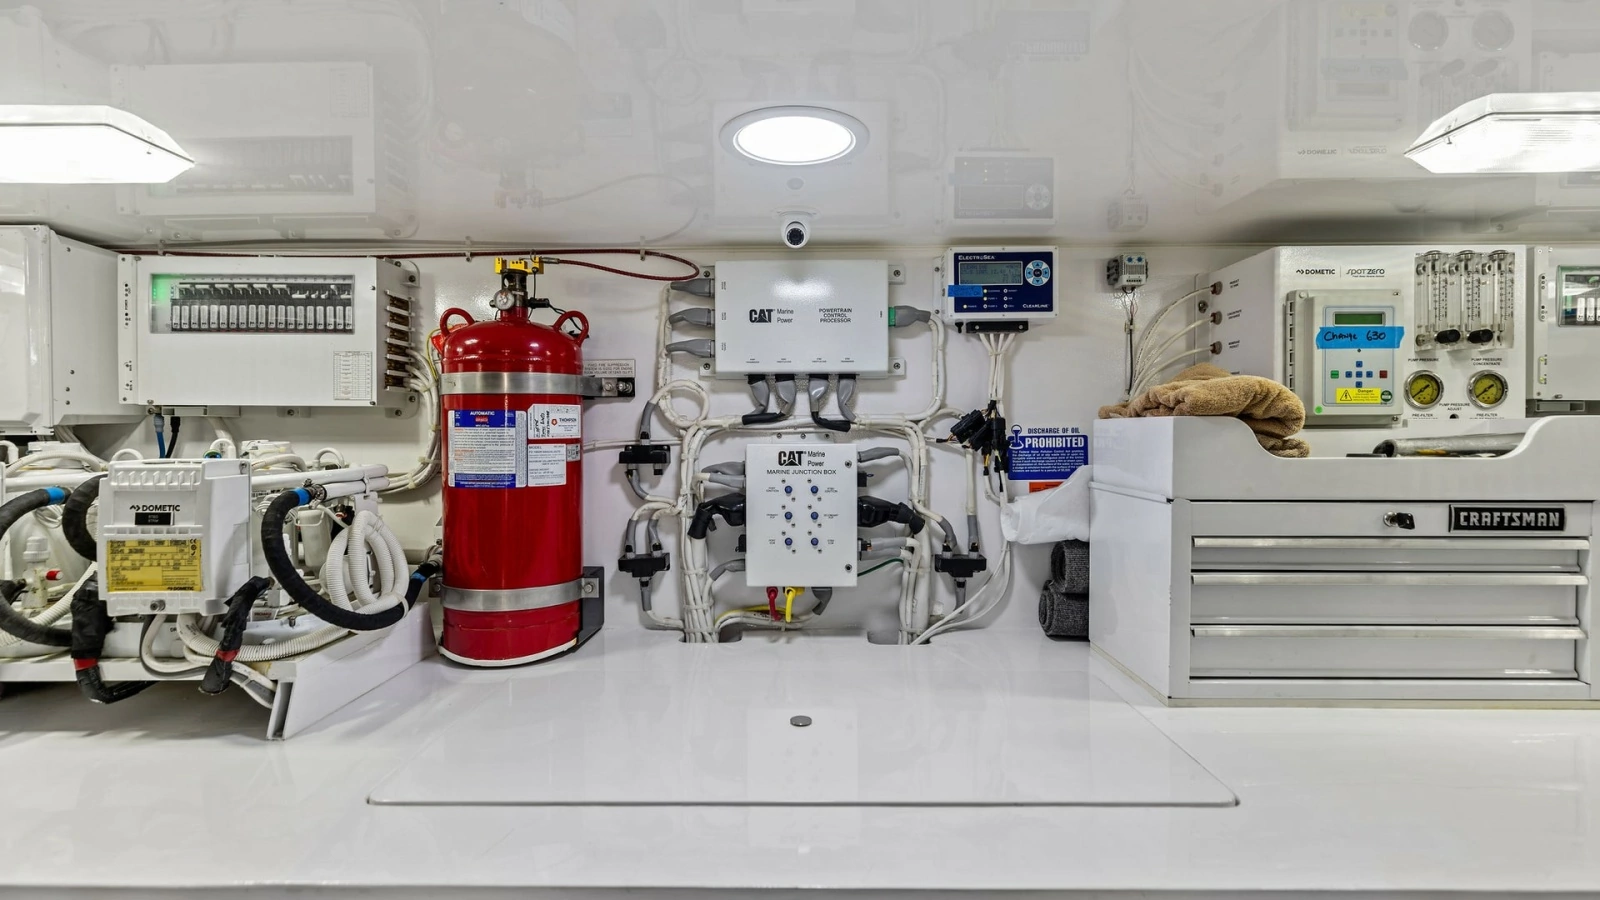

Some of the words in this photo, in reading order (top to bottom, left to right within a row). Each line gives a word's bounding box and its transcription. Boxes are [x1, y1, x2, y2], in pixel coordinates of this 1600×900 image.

[749, 308, 774, 323] CAT
[1366, 330, 1387, 341] 630
[1025, 437, 1085, 448] PROHIBITED
[778, 451, 804, 466] CAT
[1459, 511, 1560, 527] CRAFTSMAN
